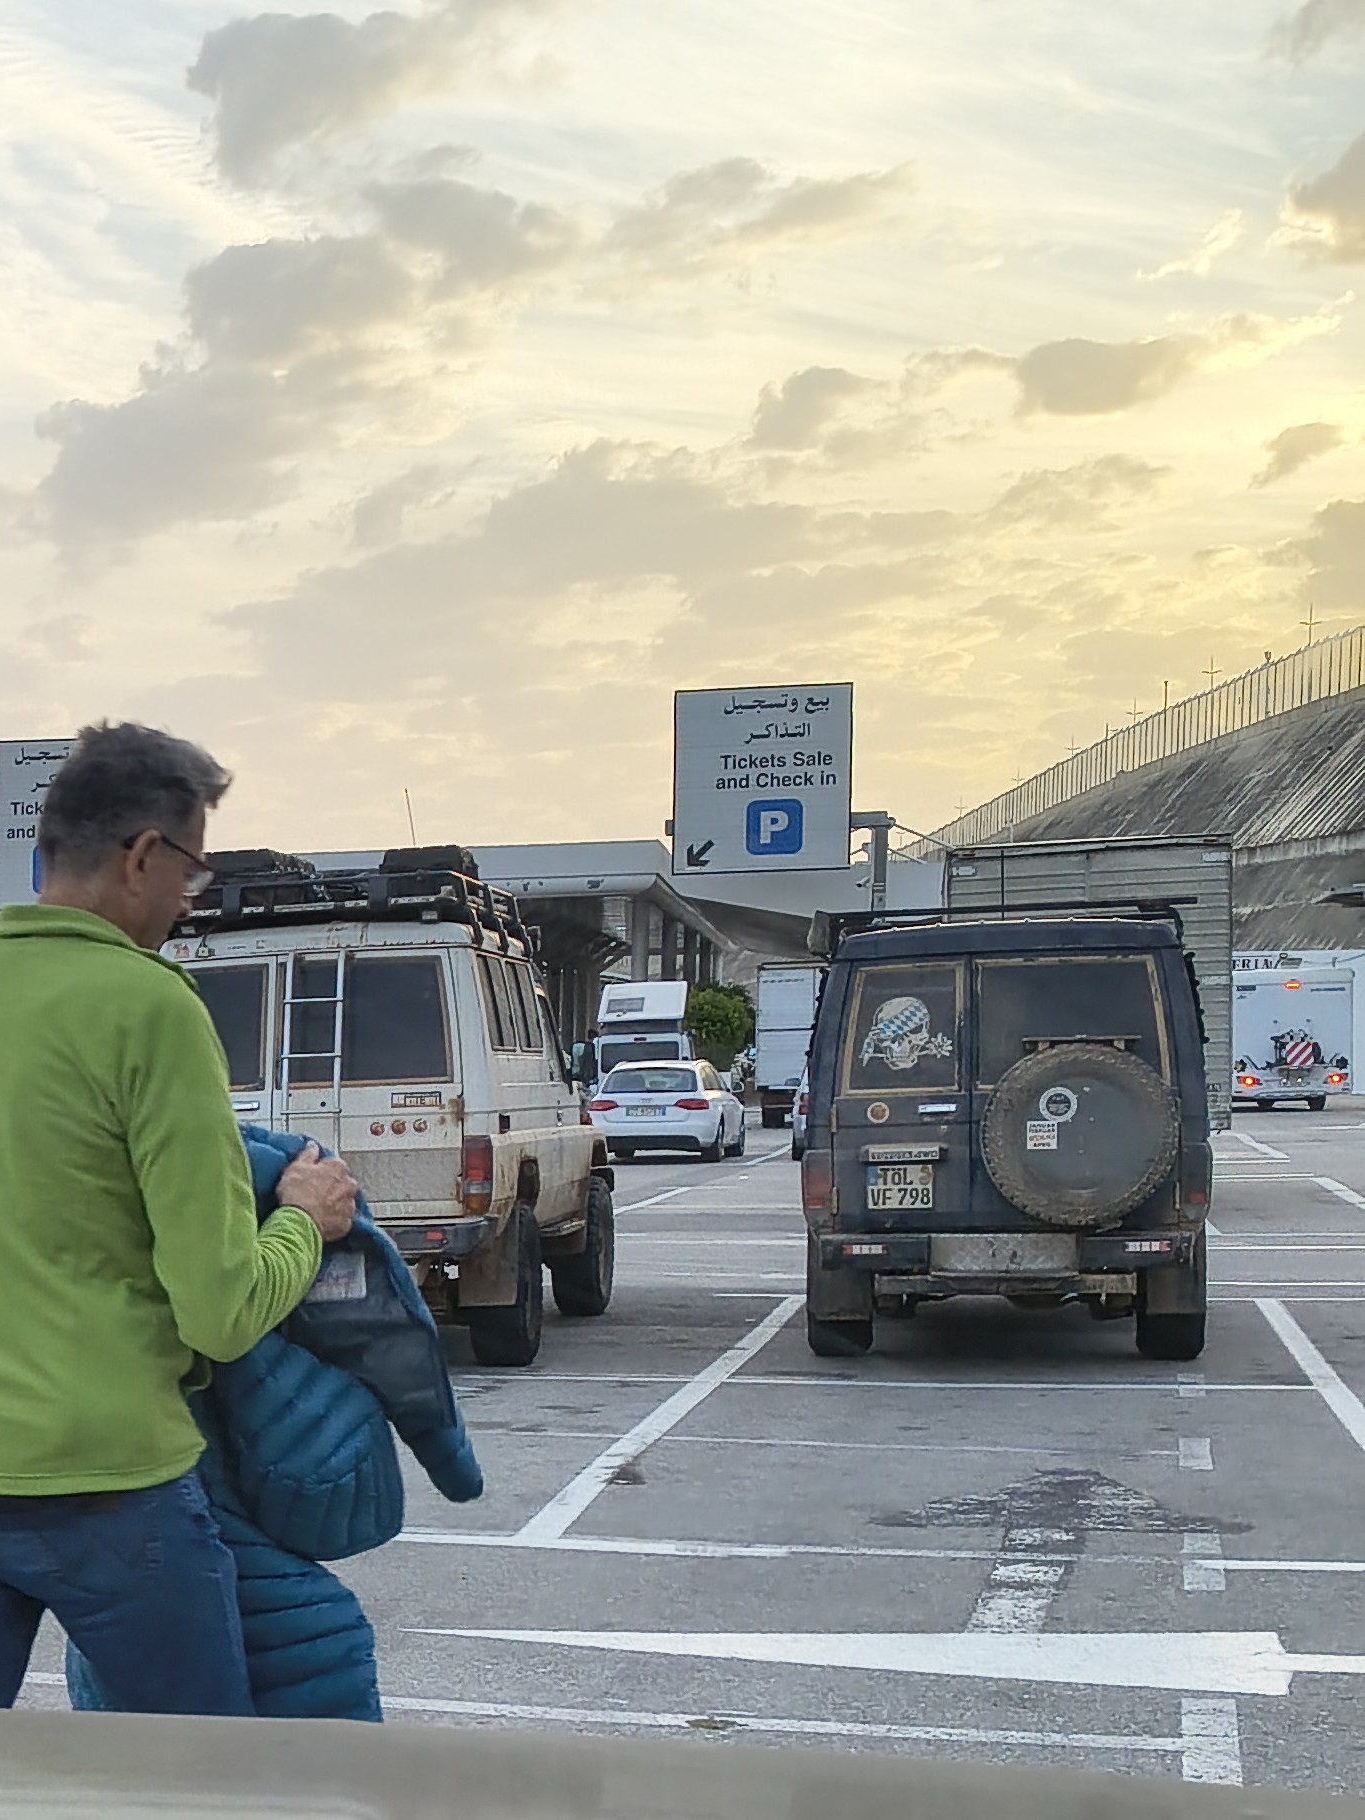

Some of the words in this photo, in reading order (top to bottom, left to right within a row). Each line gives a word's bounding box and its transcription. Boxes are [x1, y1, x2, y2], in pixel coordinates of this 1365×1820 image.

[723, 693, 799, 715] وتسجيل
[804, 696, 830, 714] بيع
[744, 722, 811, 744] التذاكر
[720, 753, 787, 770] Tickets
[792, 750, 833, 767] Sale
[716, 773, 750, 790] and
[755, 771, 814, 788] Check
[820, 770, 837, 786] in
[10, 801, 44, 816] Tick
[6, 824, 36, 839] and
[759, 810, 789, 845] P
[870, 1188, 892, 1206] VF
[897, 1187, 931, 1206] 798
